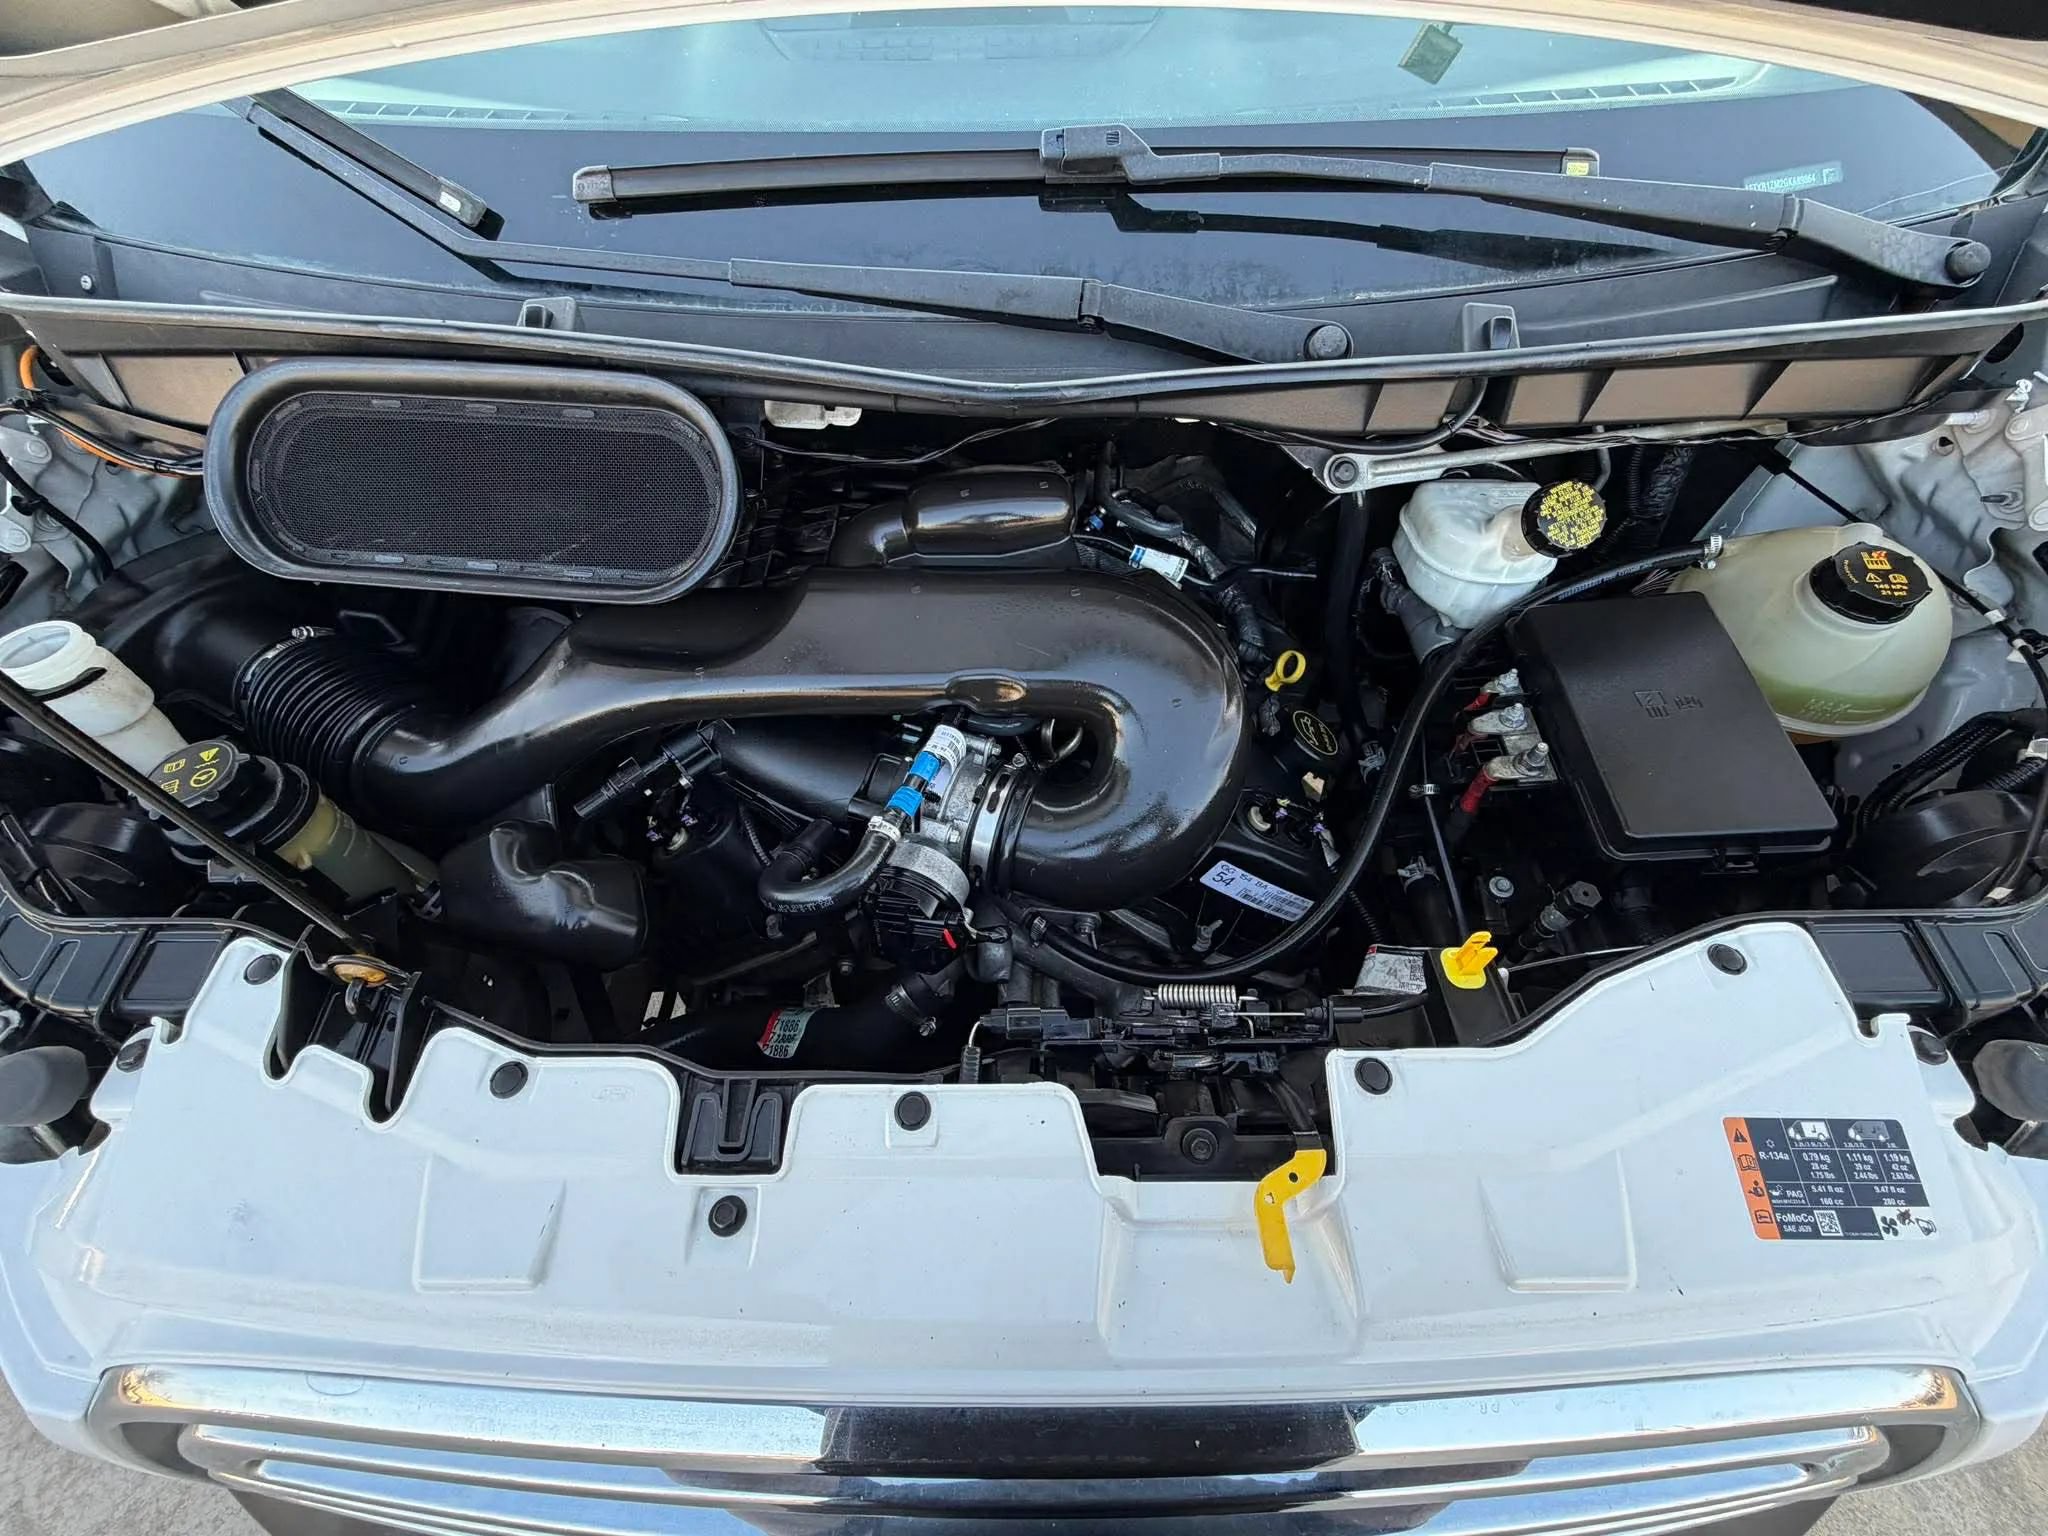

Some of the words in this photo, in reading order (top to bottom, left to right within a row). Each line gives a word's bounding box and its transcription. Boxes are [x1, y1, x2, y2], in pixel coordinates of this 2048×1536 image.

[1212, 871, 1235, 886] 54
[1759, 1150, 1790, 1161] R-134a
[1803, 1152, 1819, 1161] 0.79
[1820, 1153, 1831, 1163] kg
[1846, 1153, 1861, 1161] 1.11
[1863, 1154, 1874, 1164] kg
[1884, 1154, 1899, 1162] 1.19
[1899, 1154, 1910, 1164] kg
[1776, 1214, 1814, 1223] FoMoCo
